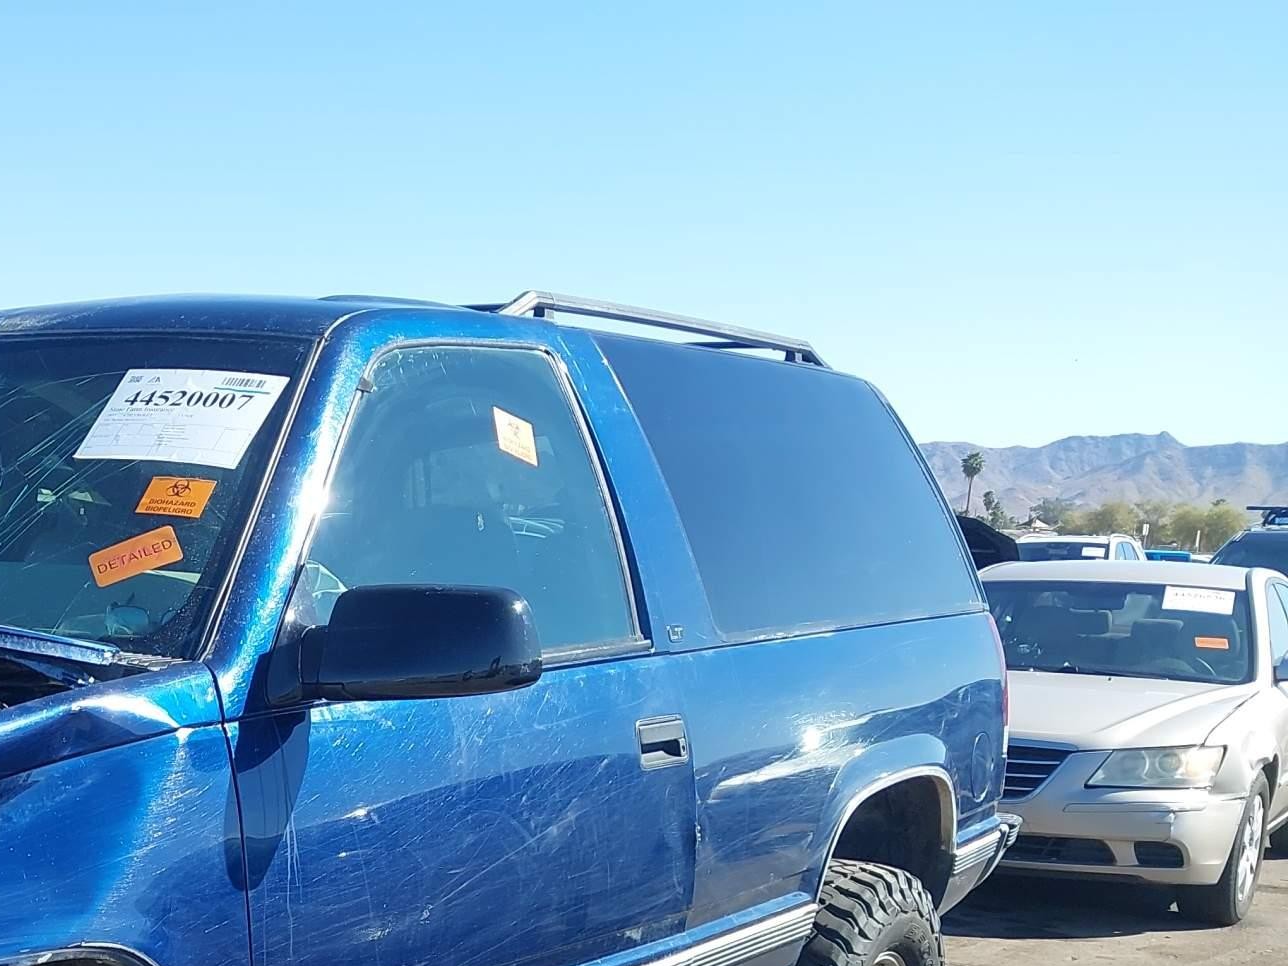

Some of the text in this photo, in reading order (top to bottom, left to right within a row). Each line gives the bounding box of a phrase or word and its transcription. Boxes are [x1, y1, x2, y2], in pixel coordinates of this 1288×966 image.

[124, 390, 255, 410] 44520007
[145, 506, 193, 515] BIOPELIGRO
[148, 499, 196, 508] BIOHAZARD
[97, 539, 173, 574] DETAILED
